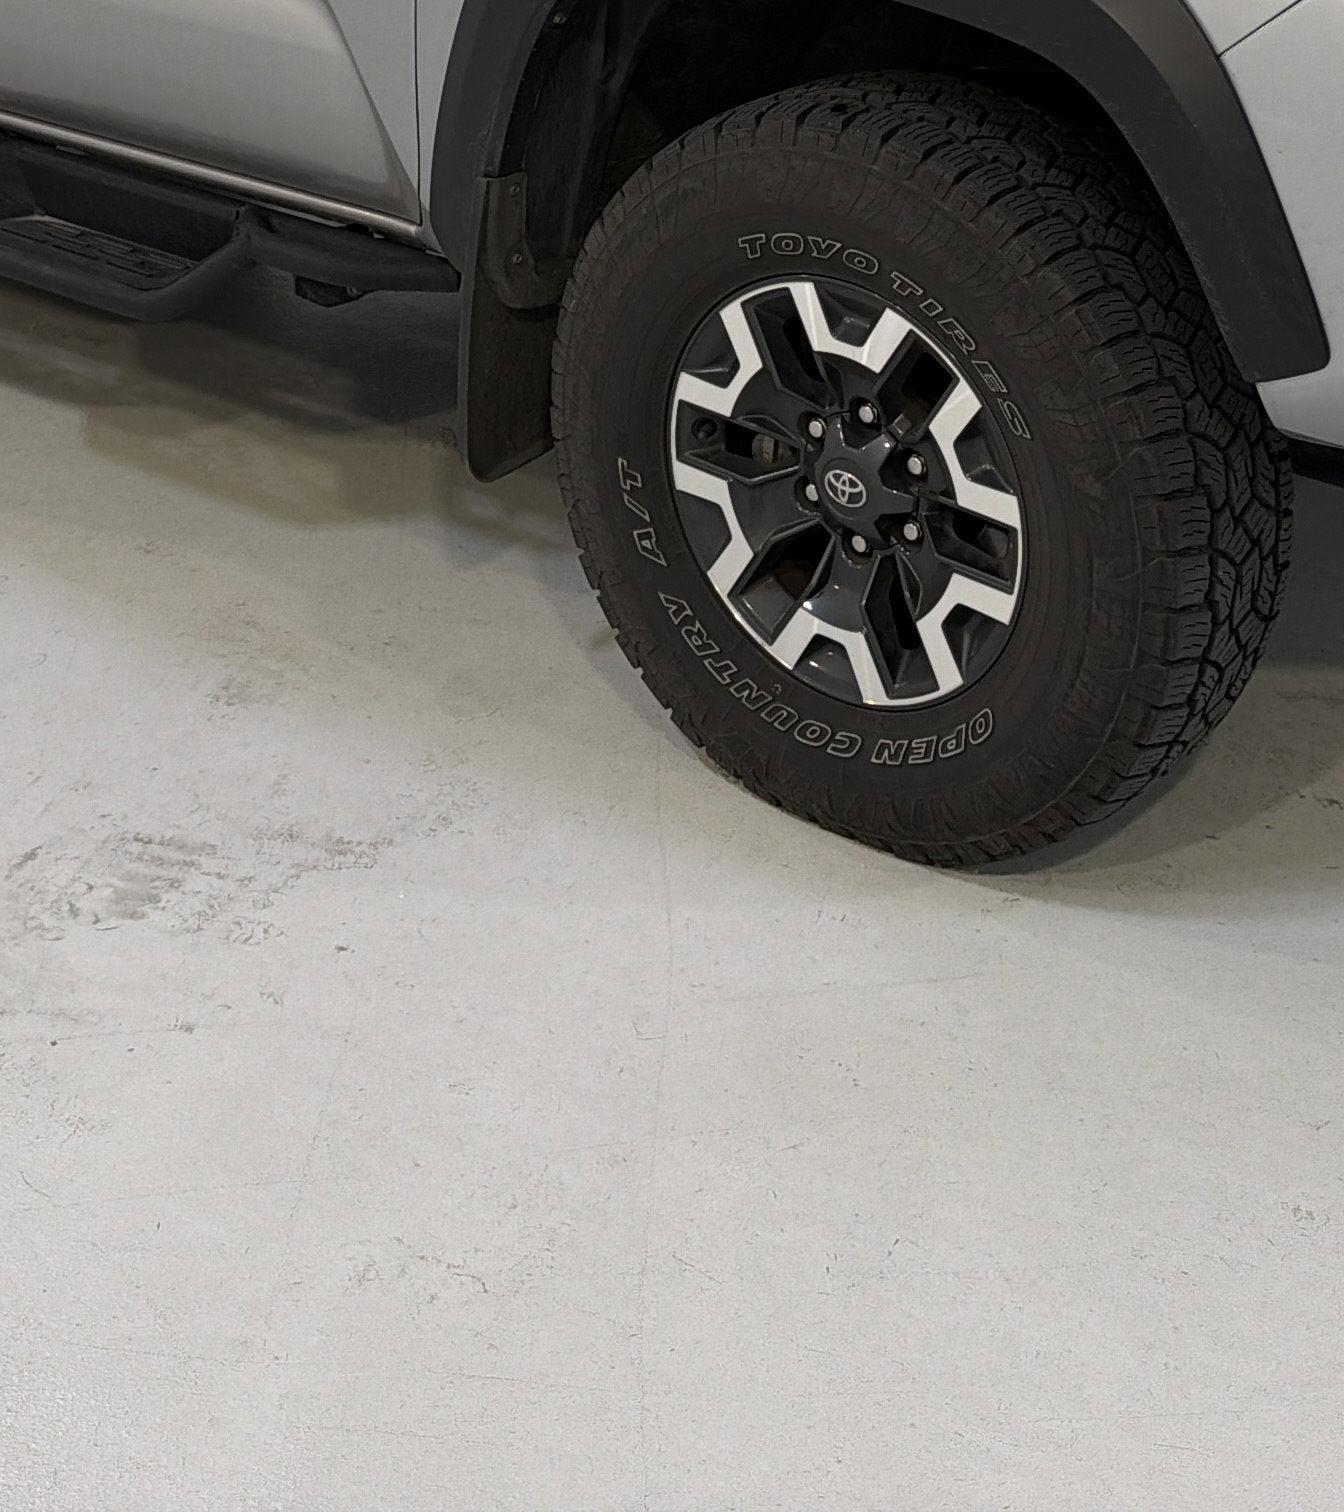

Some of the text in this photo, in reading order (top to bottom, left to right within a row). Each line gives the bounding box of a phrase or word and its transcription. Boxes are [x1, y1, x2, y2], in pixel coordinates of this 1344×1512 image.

[738, 233, 1031, 440] TOYO TIRES
[617, 457, 993, 765] OPEN COUNTRY A/T
